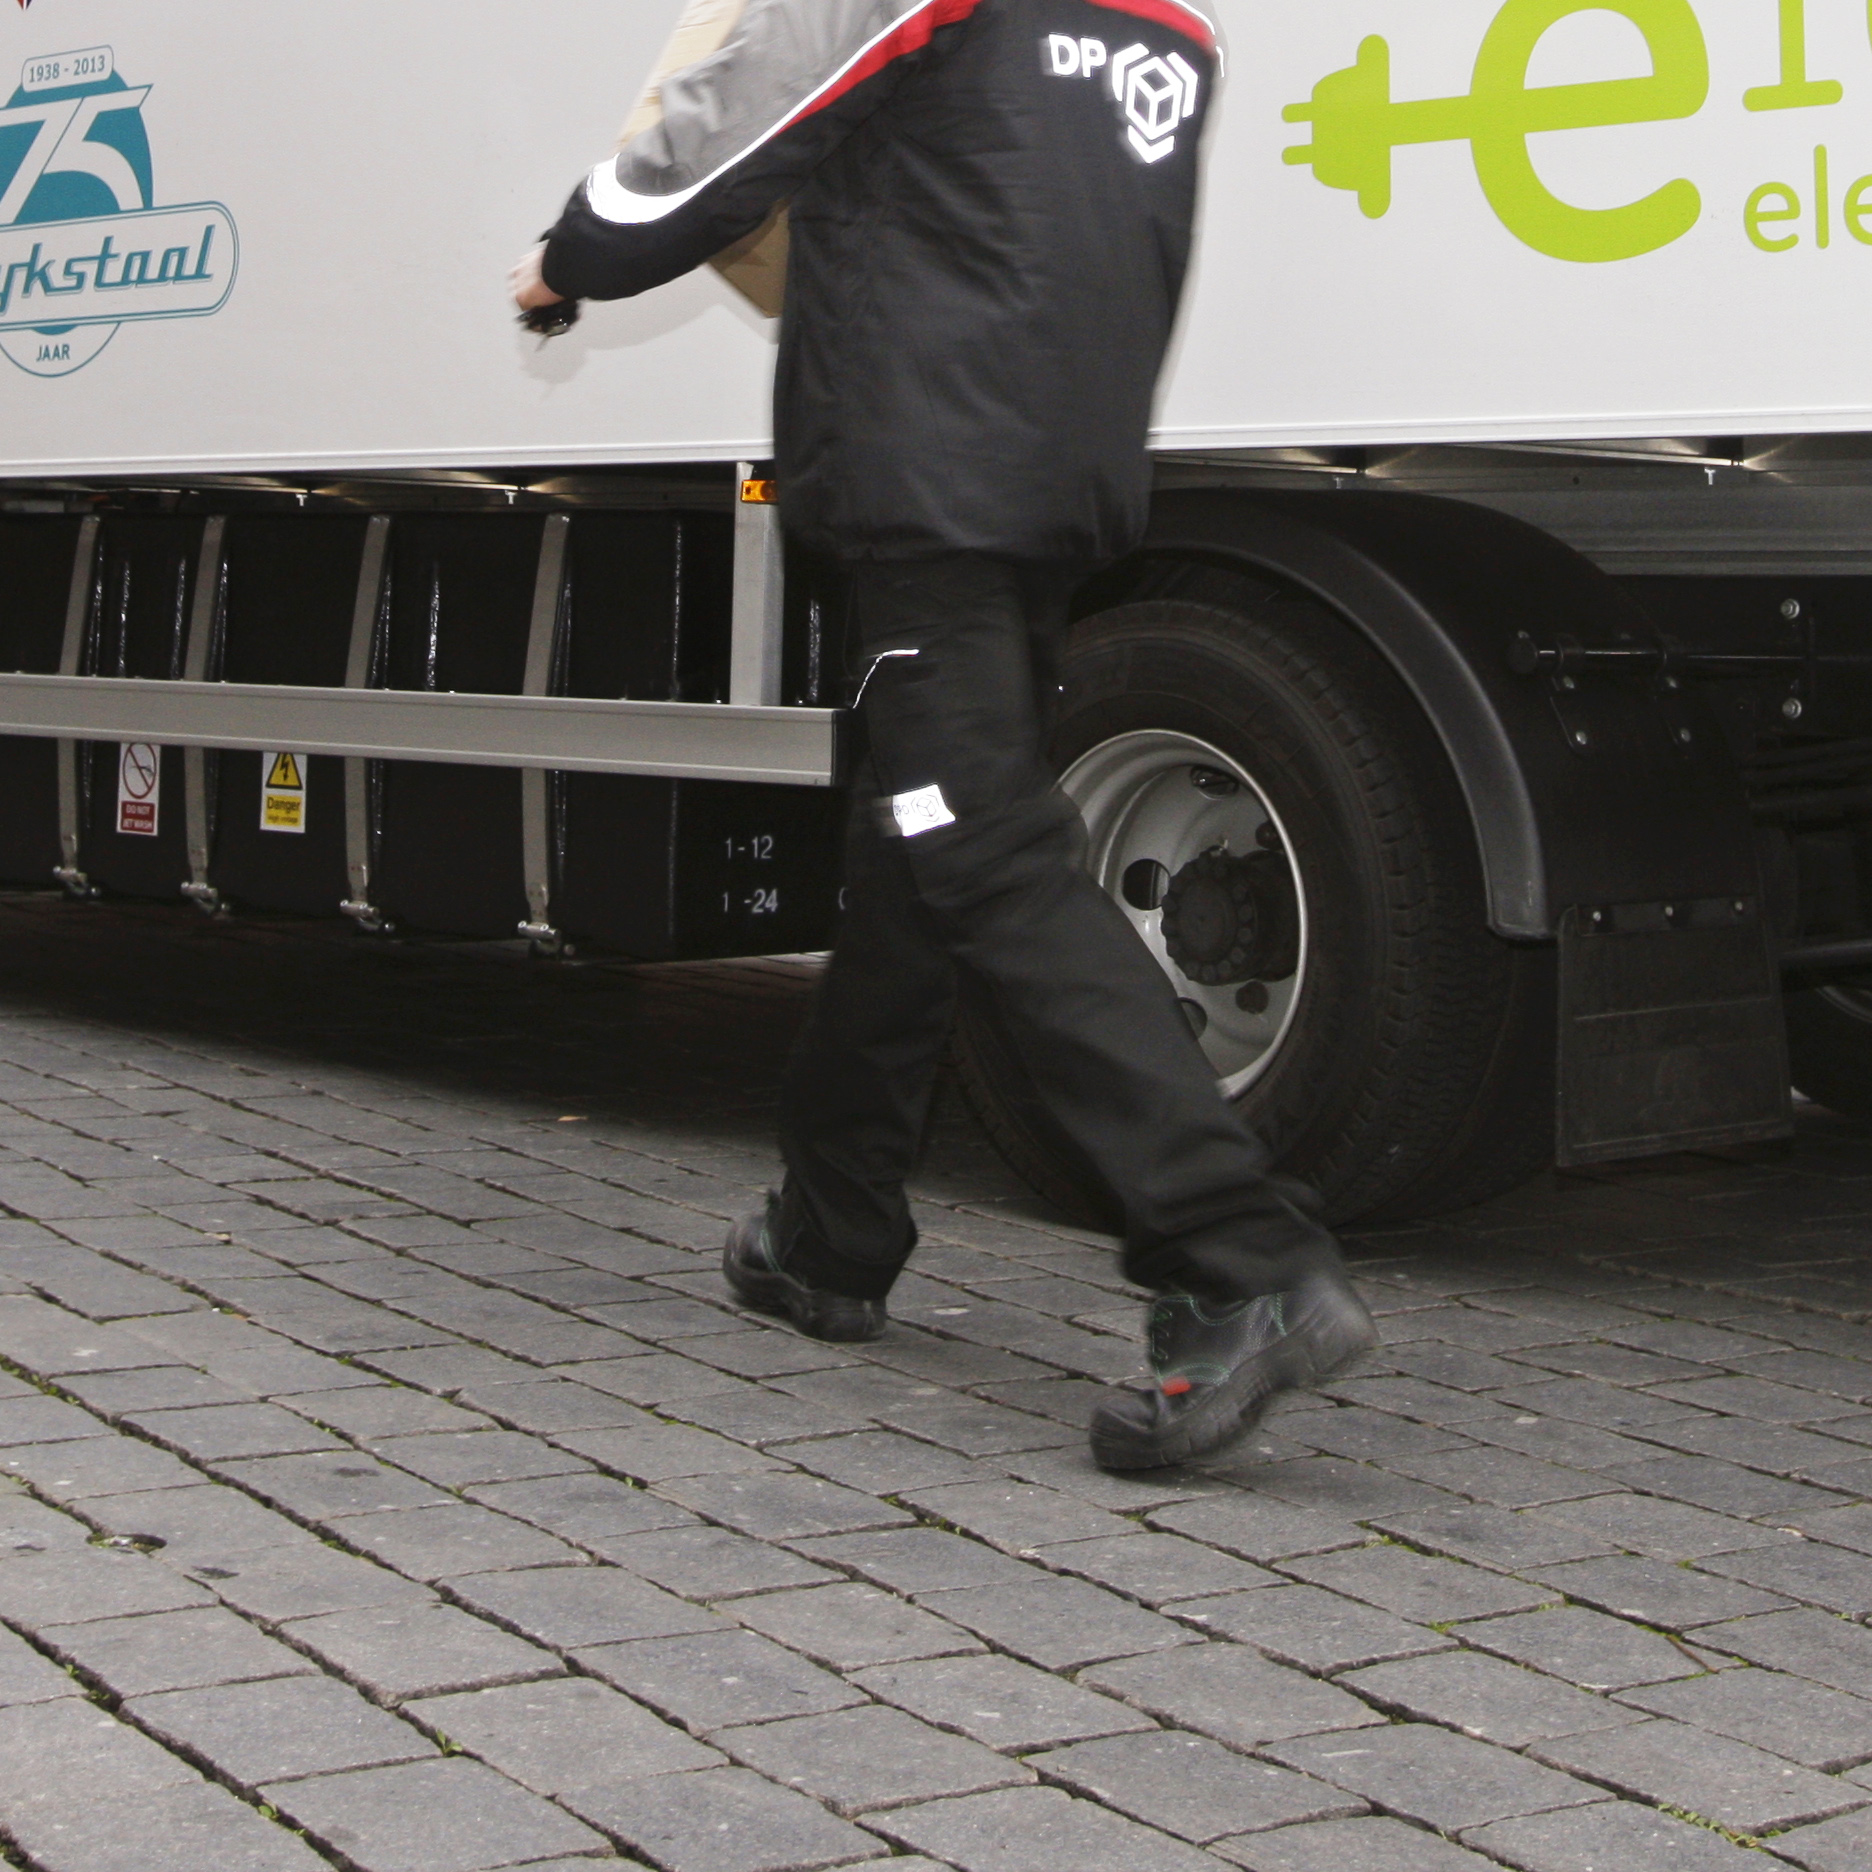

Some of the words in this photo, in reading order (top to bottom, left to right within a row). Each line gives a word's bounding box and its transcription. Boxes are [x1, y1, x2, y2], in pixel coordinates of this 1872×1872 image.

[1047, 32, 1109, 79] DP
[28, 63, 60, 84] 1938
[73, 55, 106, 77] 2013
[35, 344, 70, 362] JAAR
[266, 796, 301, 814] Danger
